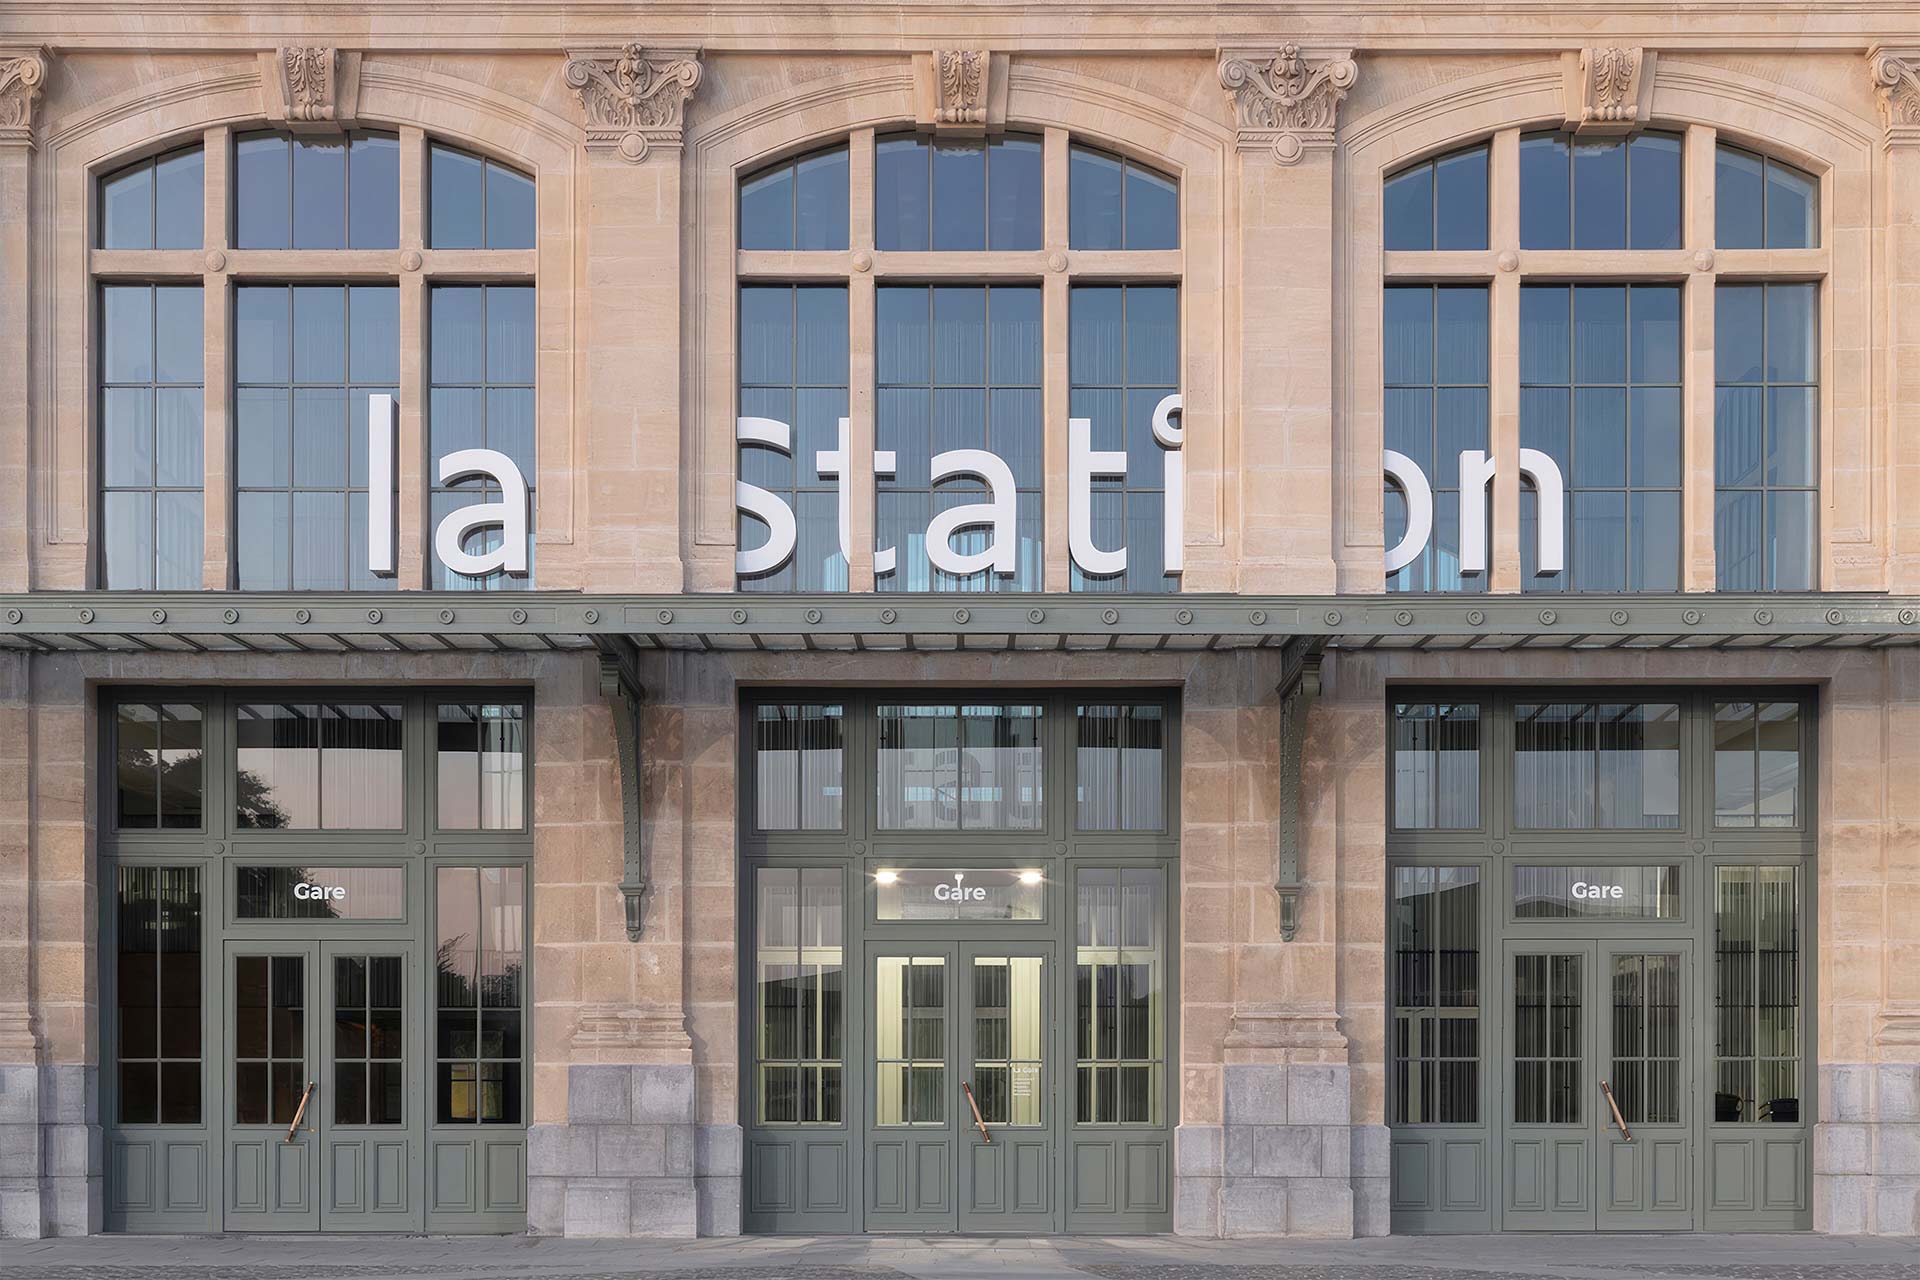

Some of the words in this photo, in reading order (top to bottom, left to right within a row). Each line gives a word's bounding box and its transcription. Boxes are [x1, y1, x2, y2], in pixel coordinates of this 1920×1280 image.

[368, 393, 529, 577] la
[293, 882, 346, 900] Gare
[934, 883, 986, 901] Gare
[1571, 881, 1624, 899] Gare
